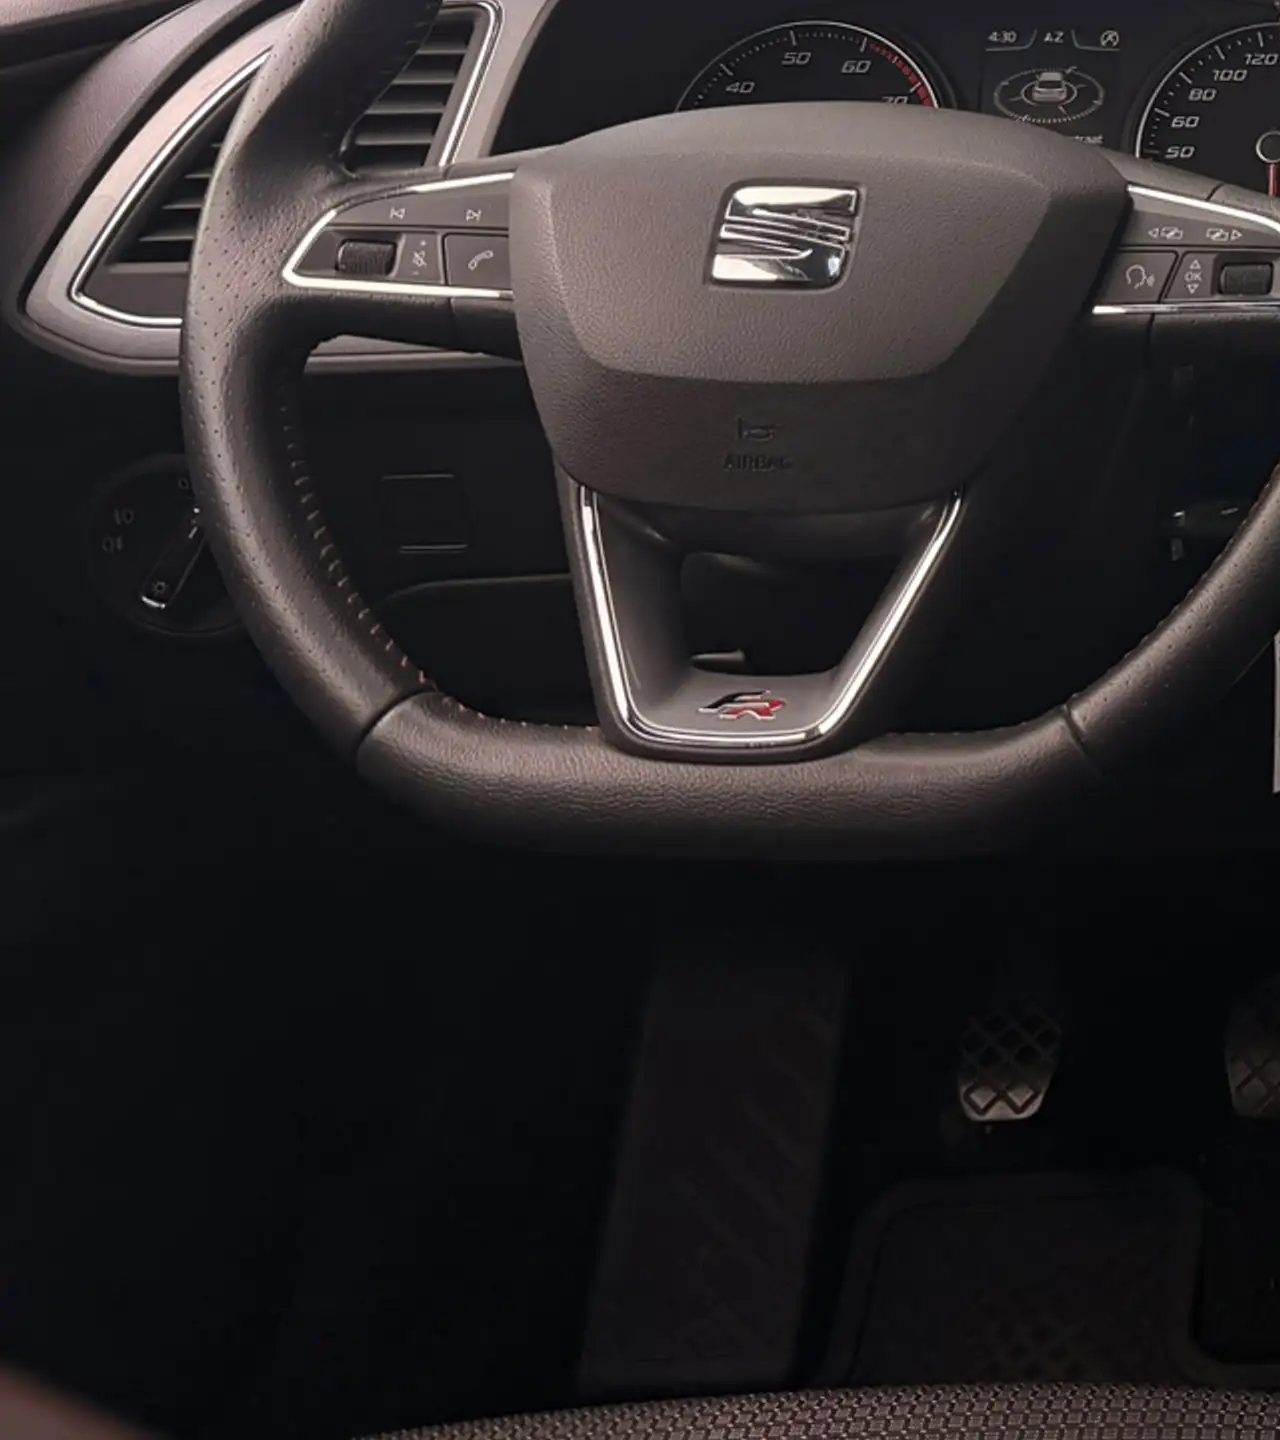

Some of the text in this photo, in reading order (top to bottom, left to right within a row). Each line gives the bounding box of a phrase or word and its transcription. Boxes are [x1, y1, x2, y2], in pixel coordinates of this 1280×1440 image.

[781, 51, 812, 66] 50
[1244, 52, 1279, 66] 120
[840, 59, 873, 74] 60
[1212, 68, 1248, 82] 100
[725, 80, 756, 95] 40
[1188, 87, 1217, 102] 80
[1170, 115, 1200, 129] 60
[1165, 145, 1195, 159] 50
[1184, 271, 1203, 283] OK
